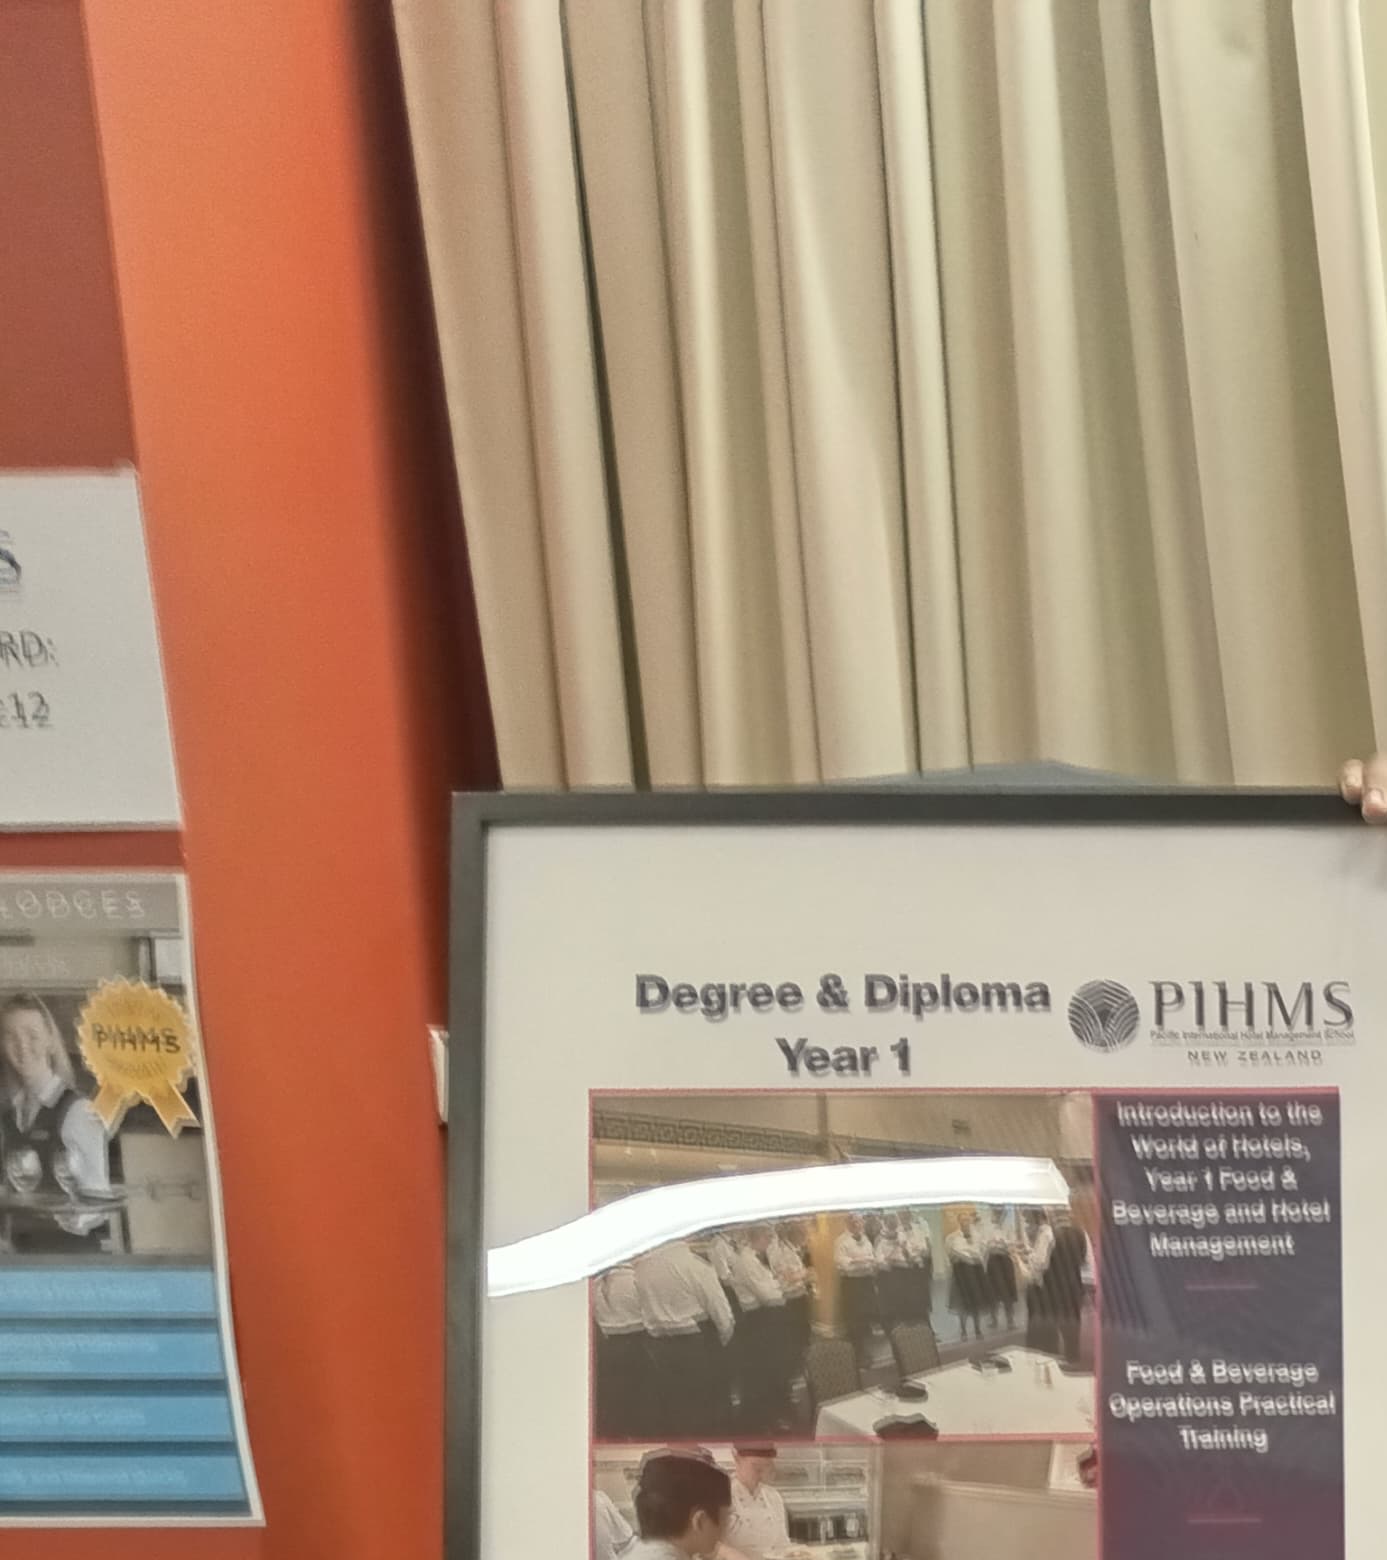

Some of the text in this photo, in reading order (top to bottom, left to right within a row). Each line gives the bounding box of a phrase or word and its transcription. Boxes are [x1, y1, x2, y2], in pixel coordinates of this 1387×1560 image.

[635, 973, 1051, 1023] Degree & Diploma
[1148, 980, 1354, 1031] PIHMS
[92, 1023, 181, 1054] PIHMS
[775, 1037, 911, 1077] Year 1
[1187, 1050, 1323, 1066] NEW ZEALAND
[1116, 1101, 1322, 1127] Introduction to the
[1131, 1134, 1311, 1162] World of Hotels,
[1145, 1167, 1297, 1191] Year 1 Food &
[1112, 1199, 1331, 1227] Beverage and Hotel
[1150, 1233, 1295, 1260] Management
[1126, 1359, 1318, 1386] Food & Beverage
[1109, 1391, 1336, 1422] Operations Practical
[1178, 1426, 1268, 1453] Training
